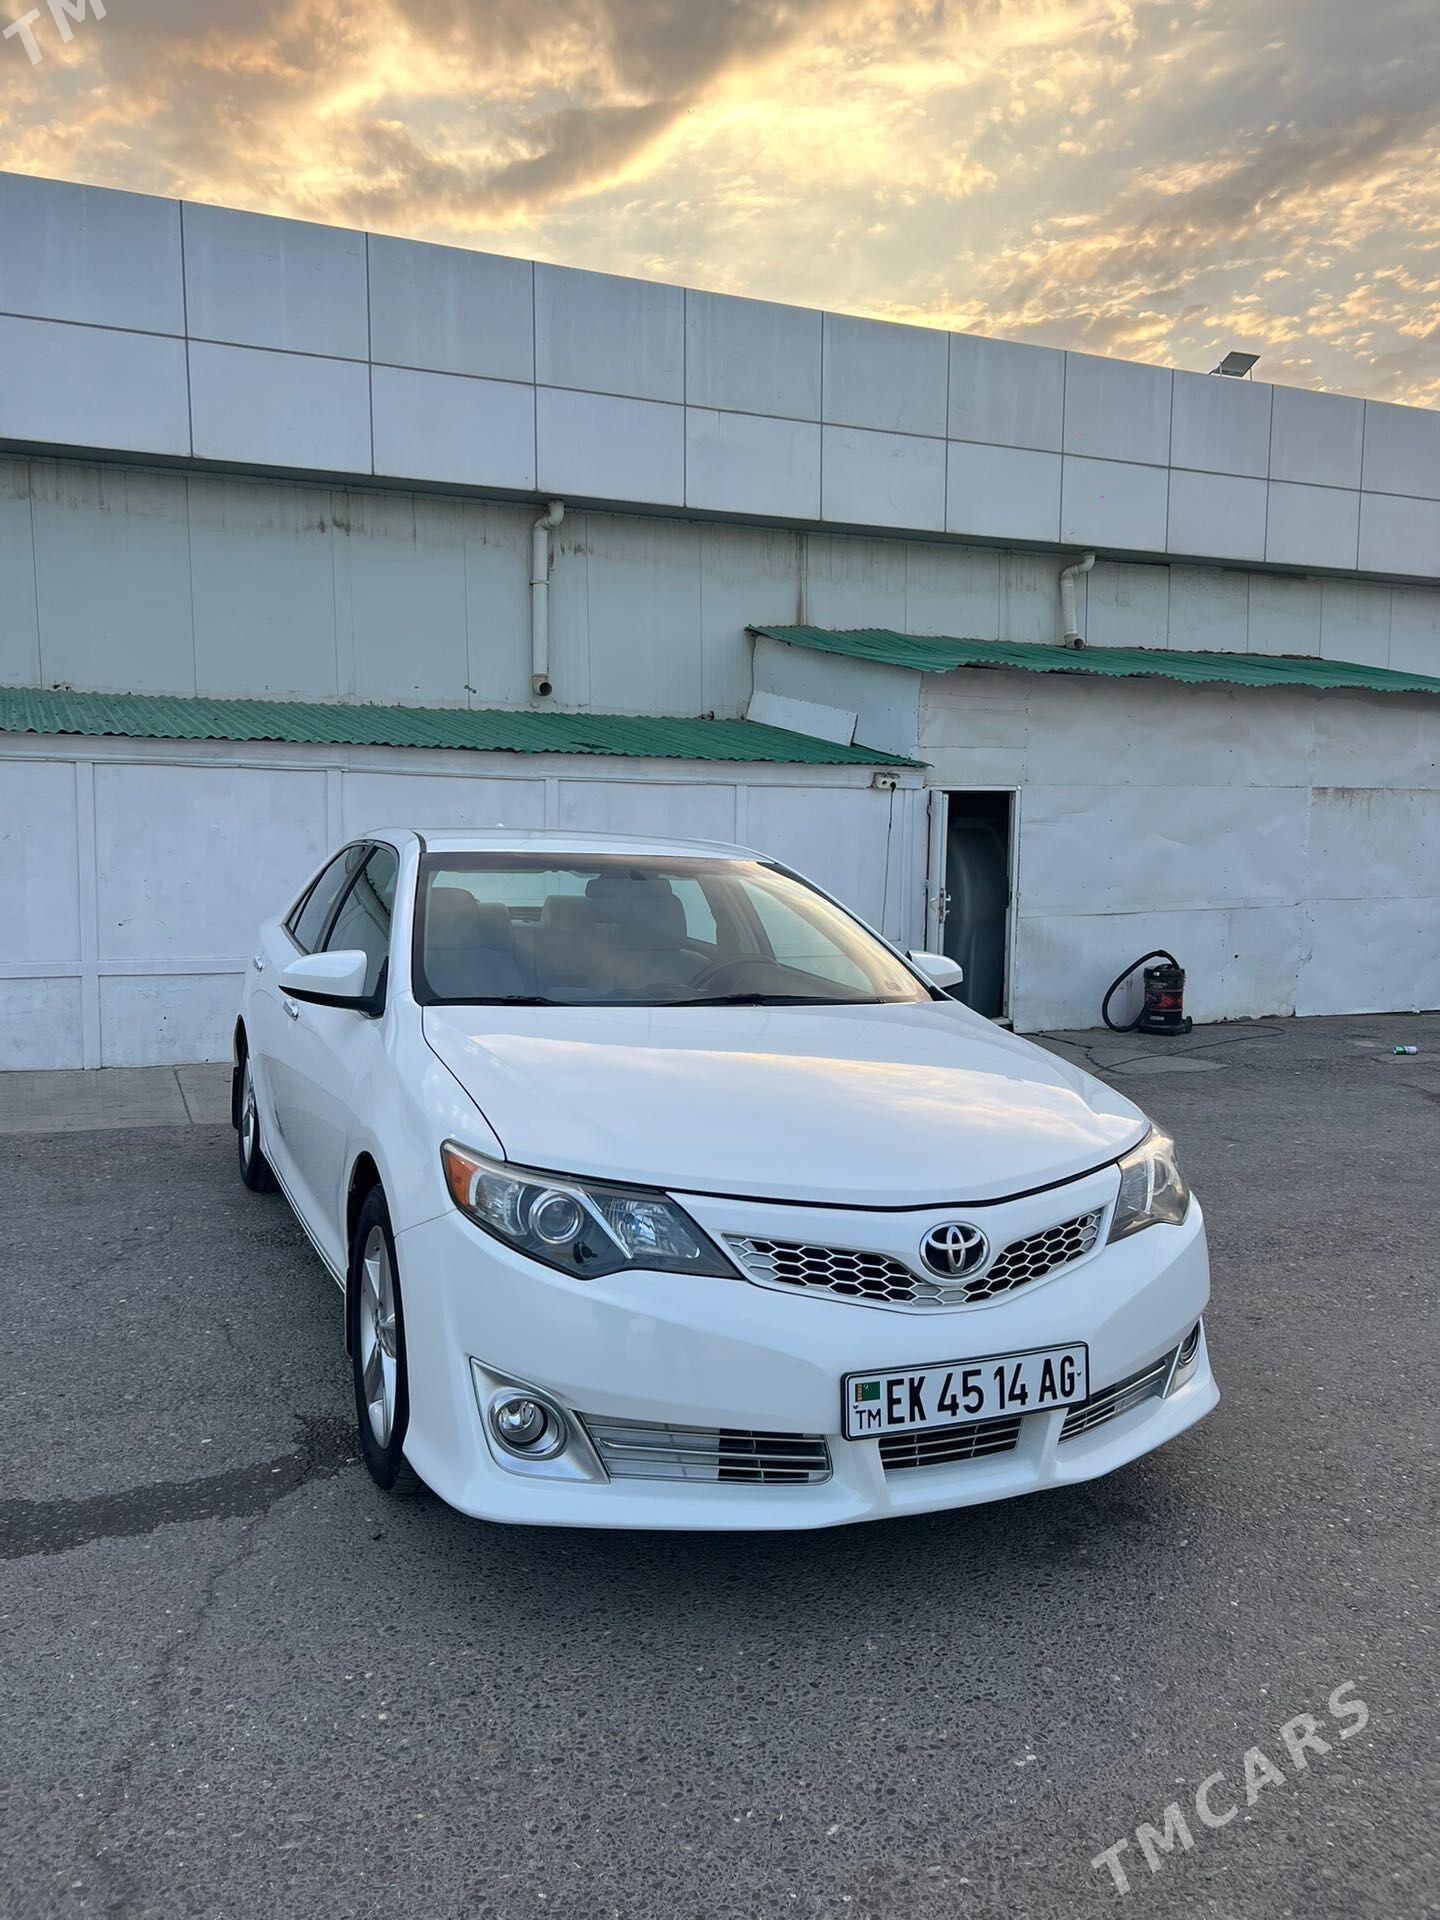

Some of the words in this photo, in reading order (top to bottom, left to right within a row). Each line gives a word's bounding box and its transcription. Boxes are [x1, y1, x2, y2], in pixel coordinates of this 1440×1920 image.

[886, 1376, 927, 1425] EK
[937, 1368, 984, 1417] 45
[993, 1362, 1028, 1410] 14
[1038, 1355, 1075, 1403] AG
[855, 1408, 882, 1430] TM
